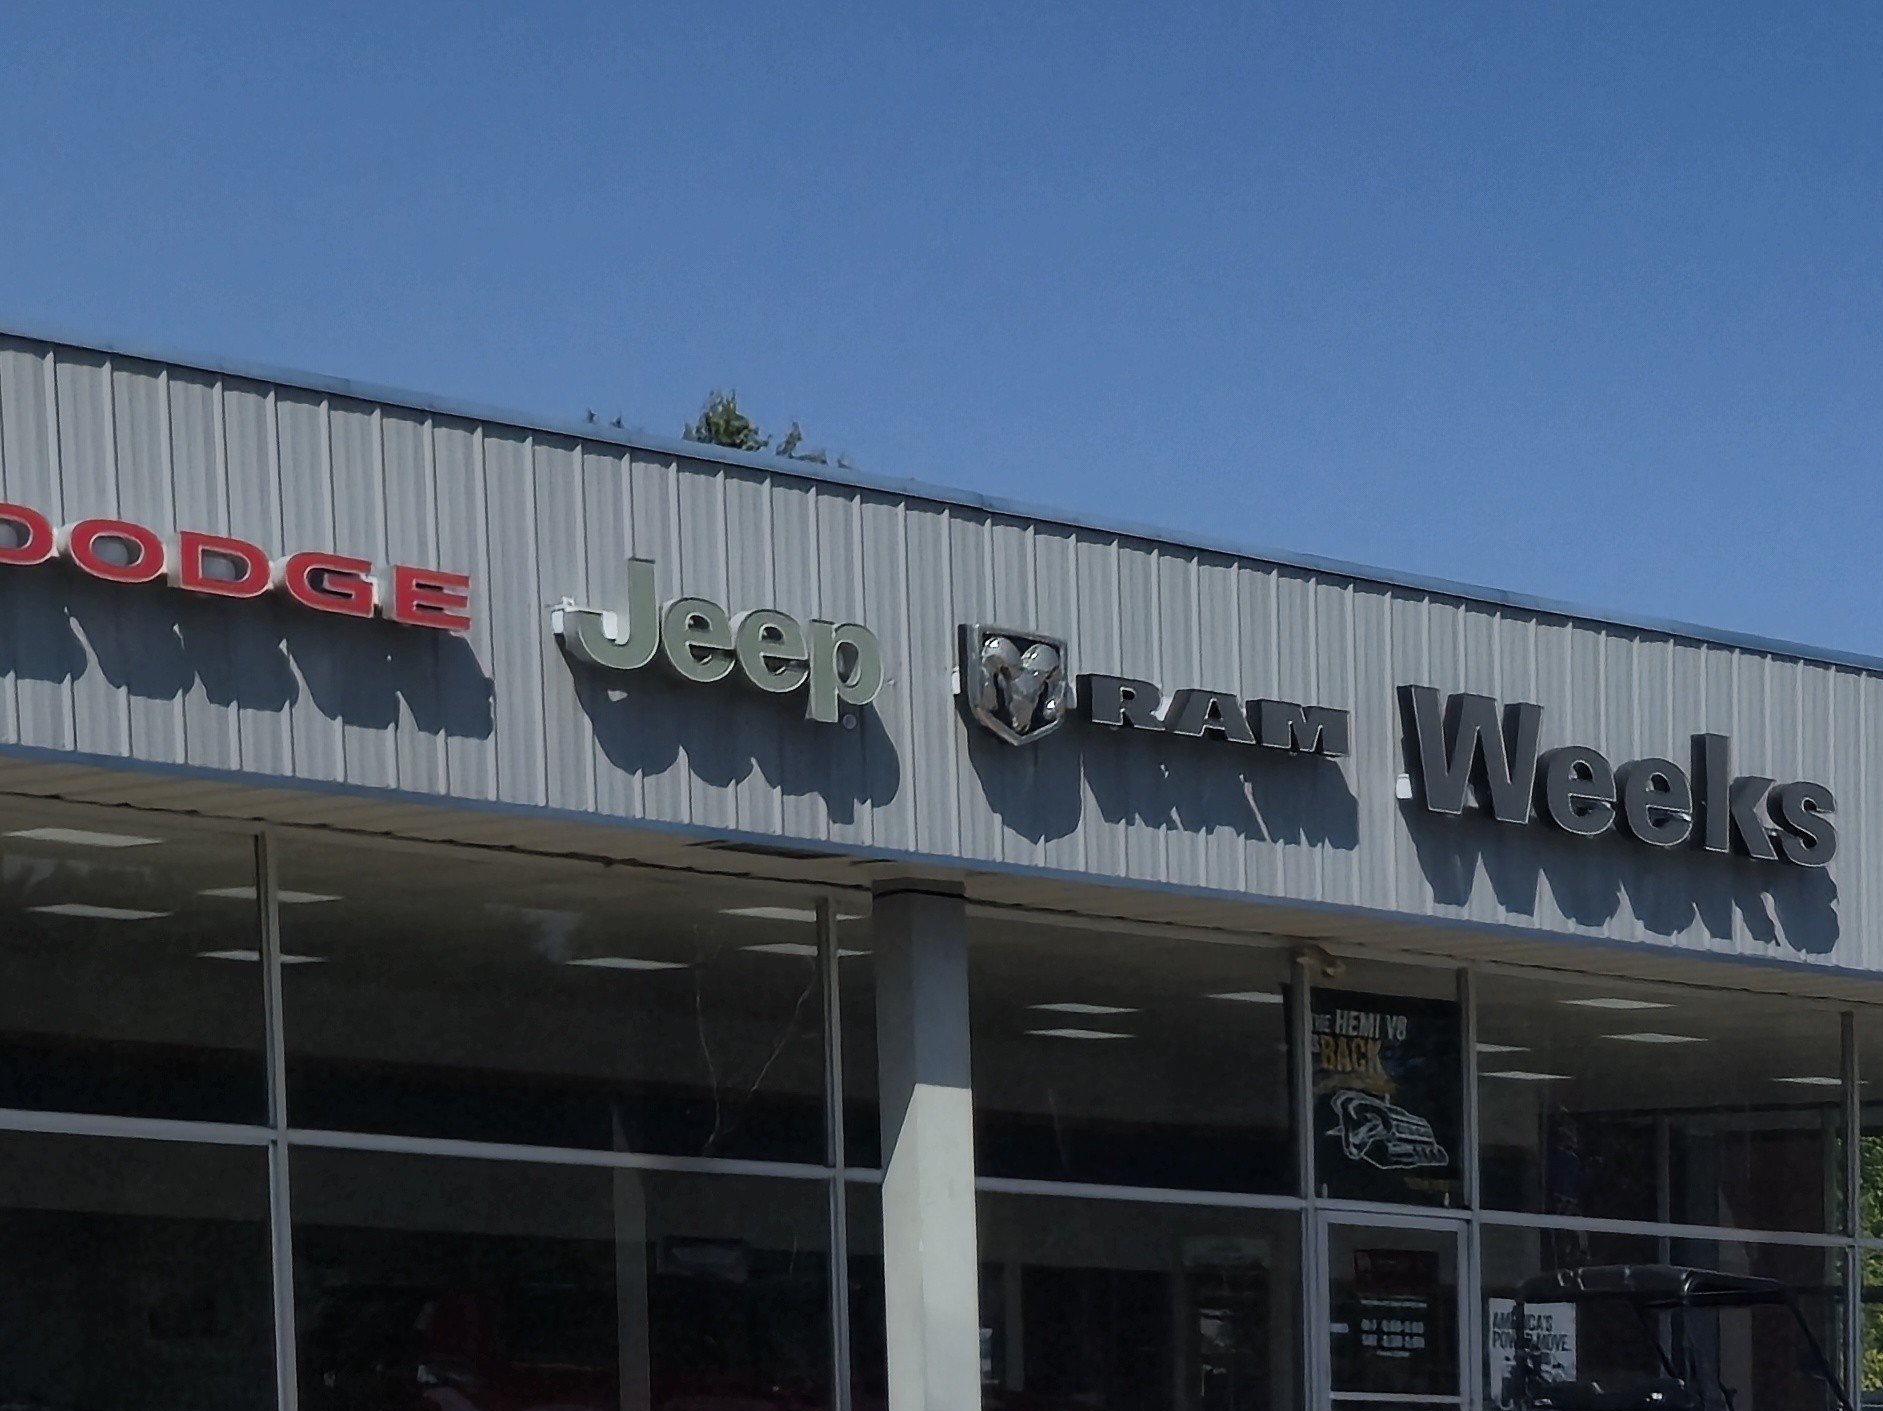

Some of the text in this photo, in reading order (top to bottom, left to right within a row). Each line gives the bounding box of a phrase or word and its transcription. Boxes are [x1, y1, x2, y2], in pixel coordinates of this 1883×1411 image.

[556, 557, 884, 723] Jeep
[1076, 673, 1350, 757] RAM
[1397, 684, 1837, 867] Weeks
[1320, 1034, 1384, 1074] BACK
[1336, 1008, 1380, 1039] HEMI
[1386, 1014, 1407, 1041] V8
